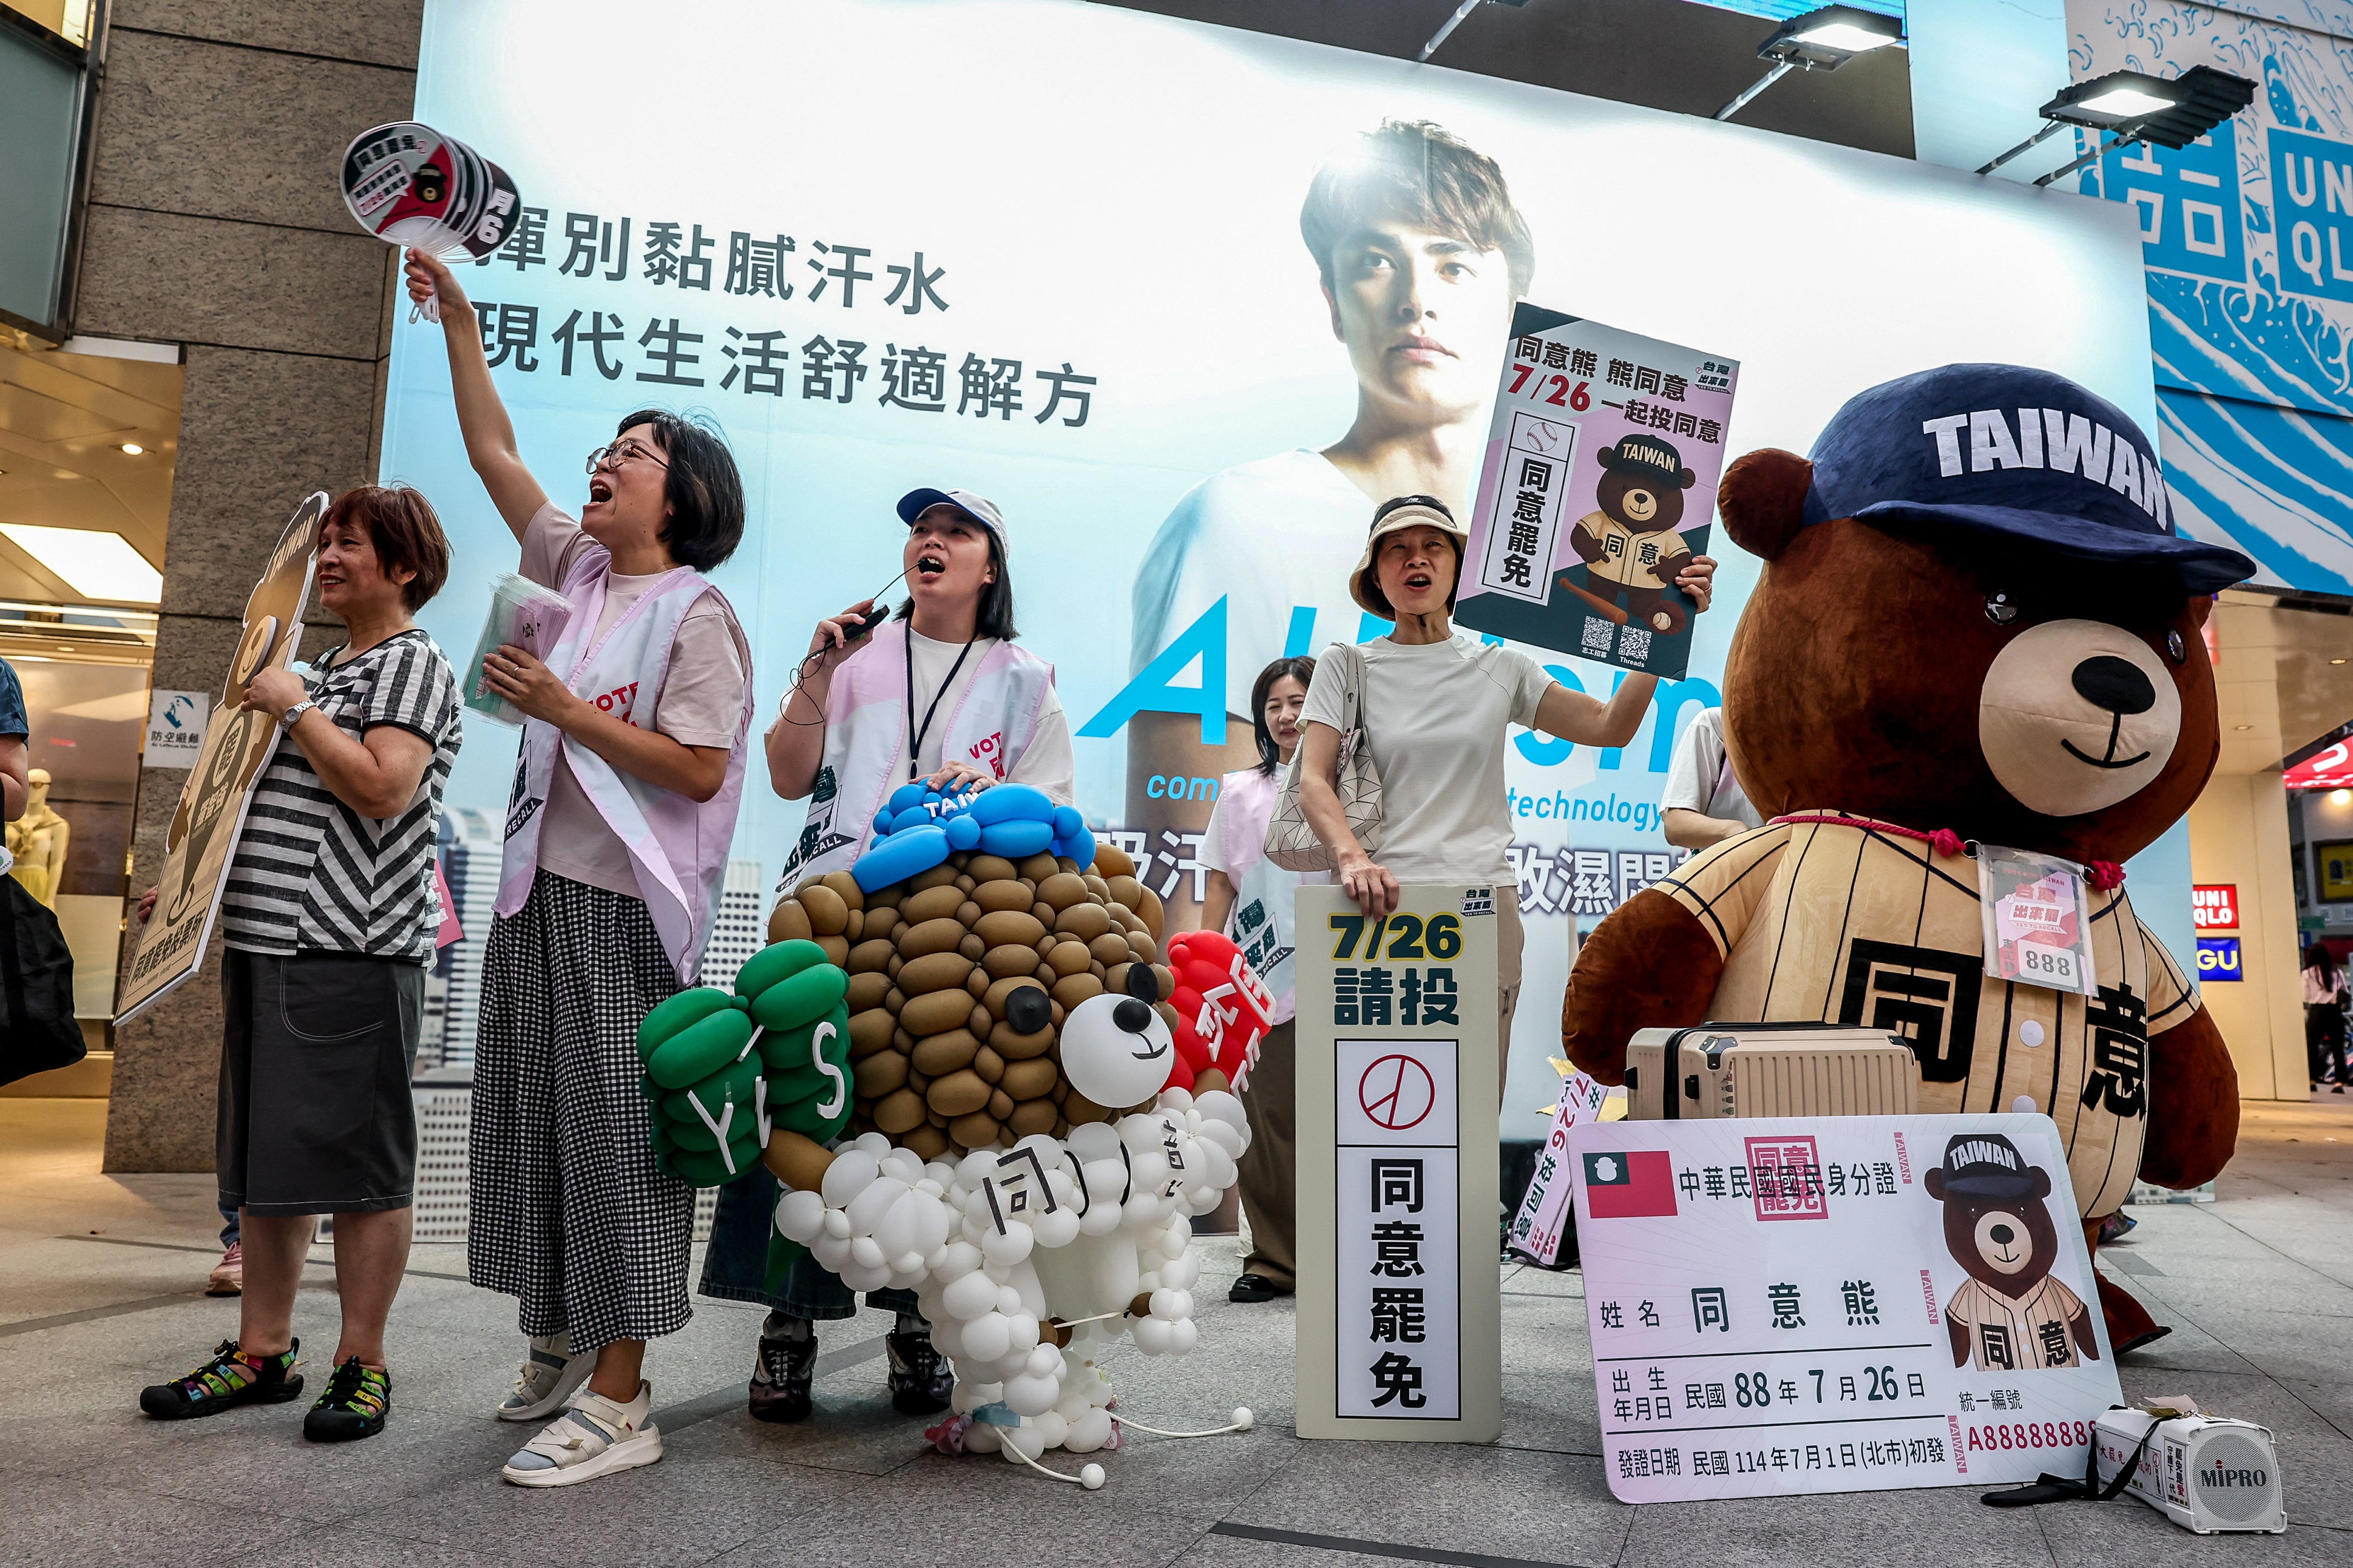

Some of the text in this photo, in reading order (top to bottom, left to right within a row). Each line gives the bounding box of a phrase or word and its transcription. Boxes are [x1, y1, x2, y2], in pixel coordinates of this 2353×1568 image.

[2284, 152, 2353, 217] UN
[475, 206, 949, 315] 揮別黏膩汗水
[2291, 220, 2353, 286] QL
[470, 301, 1097, 428] 現代生活舒適解方
[1514, 334, 1688, 402] 同意熊 熊同意
[1507, 363, 1722, 445] 7/26 一起投同意
[1622, 444, 1676, 473] TAIWAN
[1923, 408, 2167, 531] TAIWAN
[1500, 458, 1552, 589] 同意罷免
[268, 513, 316, 583] TAIWAN
[1619, 656, 1645, 668] Threads
[969, 731, 1001, 760] VOT
[507, 800, 535, 836] RECALL
[923, 792, 983, 817] TAIW
[1506, 787, 1664, 832] technology
[808, 836, 842, 860] CALL
[2015, 883, 2056, 903] 台灣
[2192, 890, 2228, 907] UNI
[1328, 912, 1463, 961] 7/26
[2193, 907, 2233, 927] QLO
[1244, 923, 1276, 969] 來罷
[1263, 949, 1288, 975] RECALL
[2025, 950, 2070, 976] 888
[2196, 948, 2238, 970] GU
[1333, 967, 1459, 1026] 請投
[1895, 1135, 1911, 1180] TAIWAN
[1949, 1140, 2017, 1171] TAIWAN
[1679, 1161, 1898, 1203] 中華民國國民身分證
[1369, 1158, 1427, 1408] 同意罷免
[1921, 1271, 1938, 1323] TAIWAN
[1614, 1396, 1672, 1422] 年月日
[1959, 1390, 2023, 1413] 統一編號
[1619, 1447, 1681, 1479] 發證日期
[1949, 1417, 1966, 1472] TAIWAN
[2100, 1444, 2152, 1475] 大罷免成功
